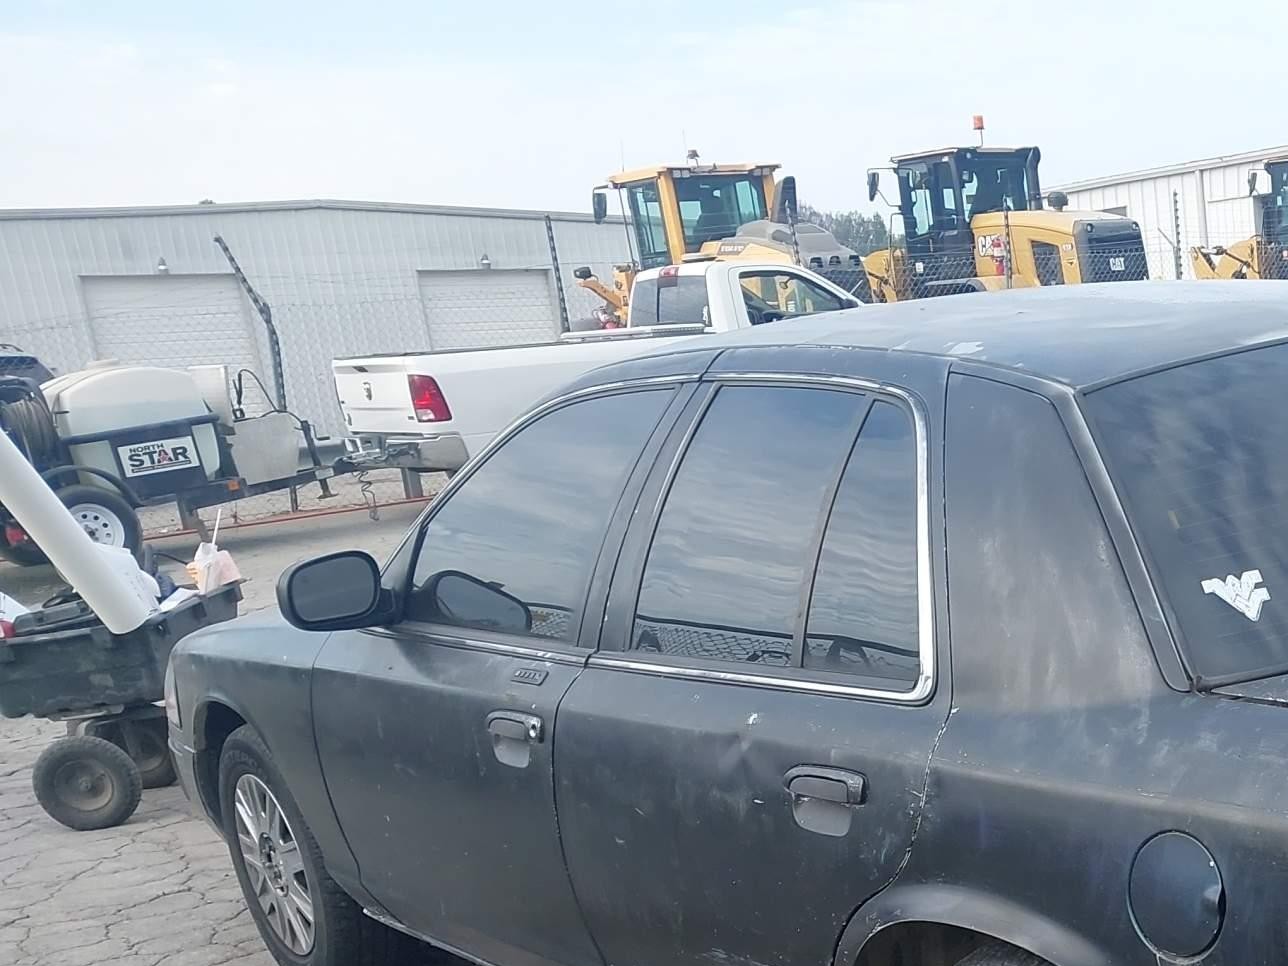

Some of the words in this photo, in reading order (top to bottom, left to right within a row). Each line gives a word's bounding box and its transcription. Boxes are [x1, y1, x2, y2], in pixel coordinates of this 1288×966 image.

[1109, 257, 1126, 271] CAT
[128, 443, 164, 453] NORTH
[128, 446, 191, 467] STAR
